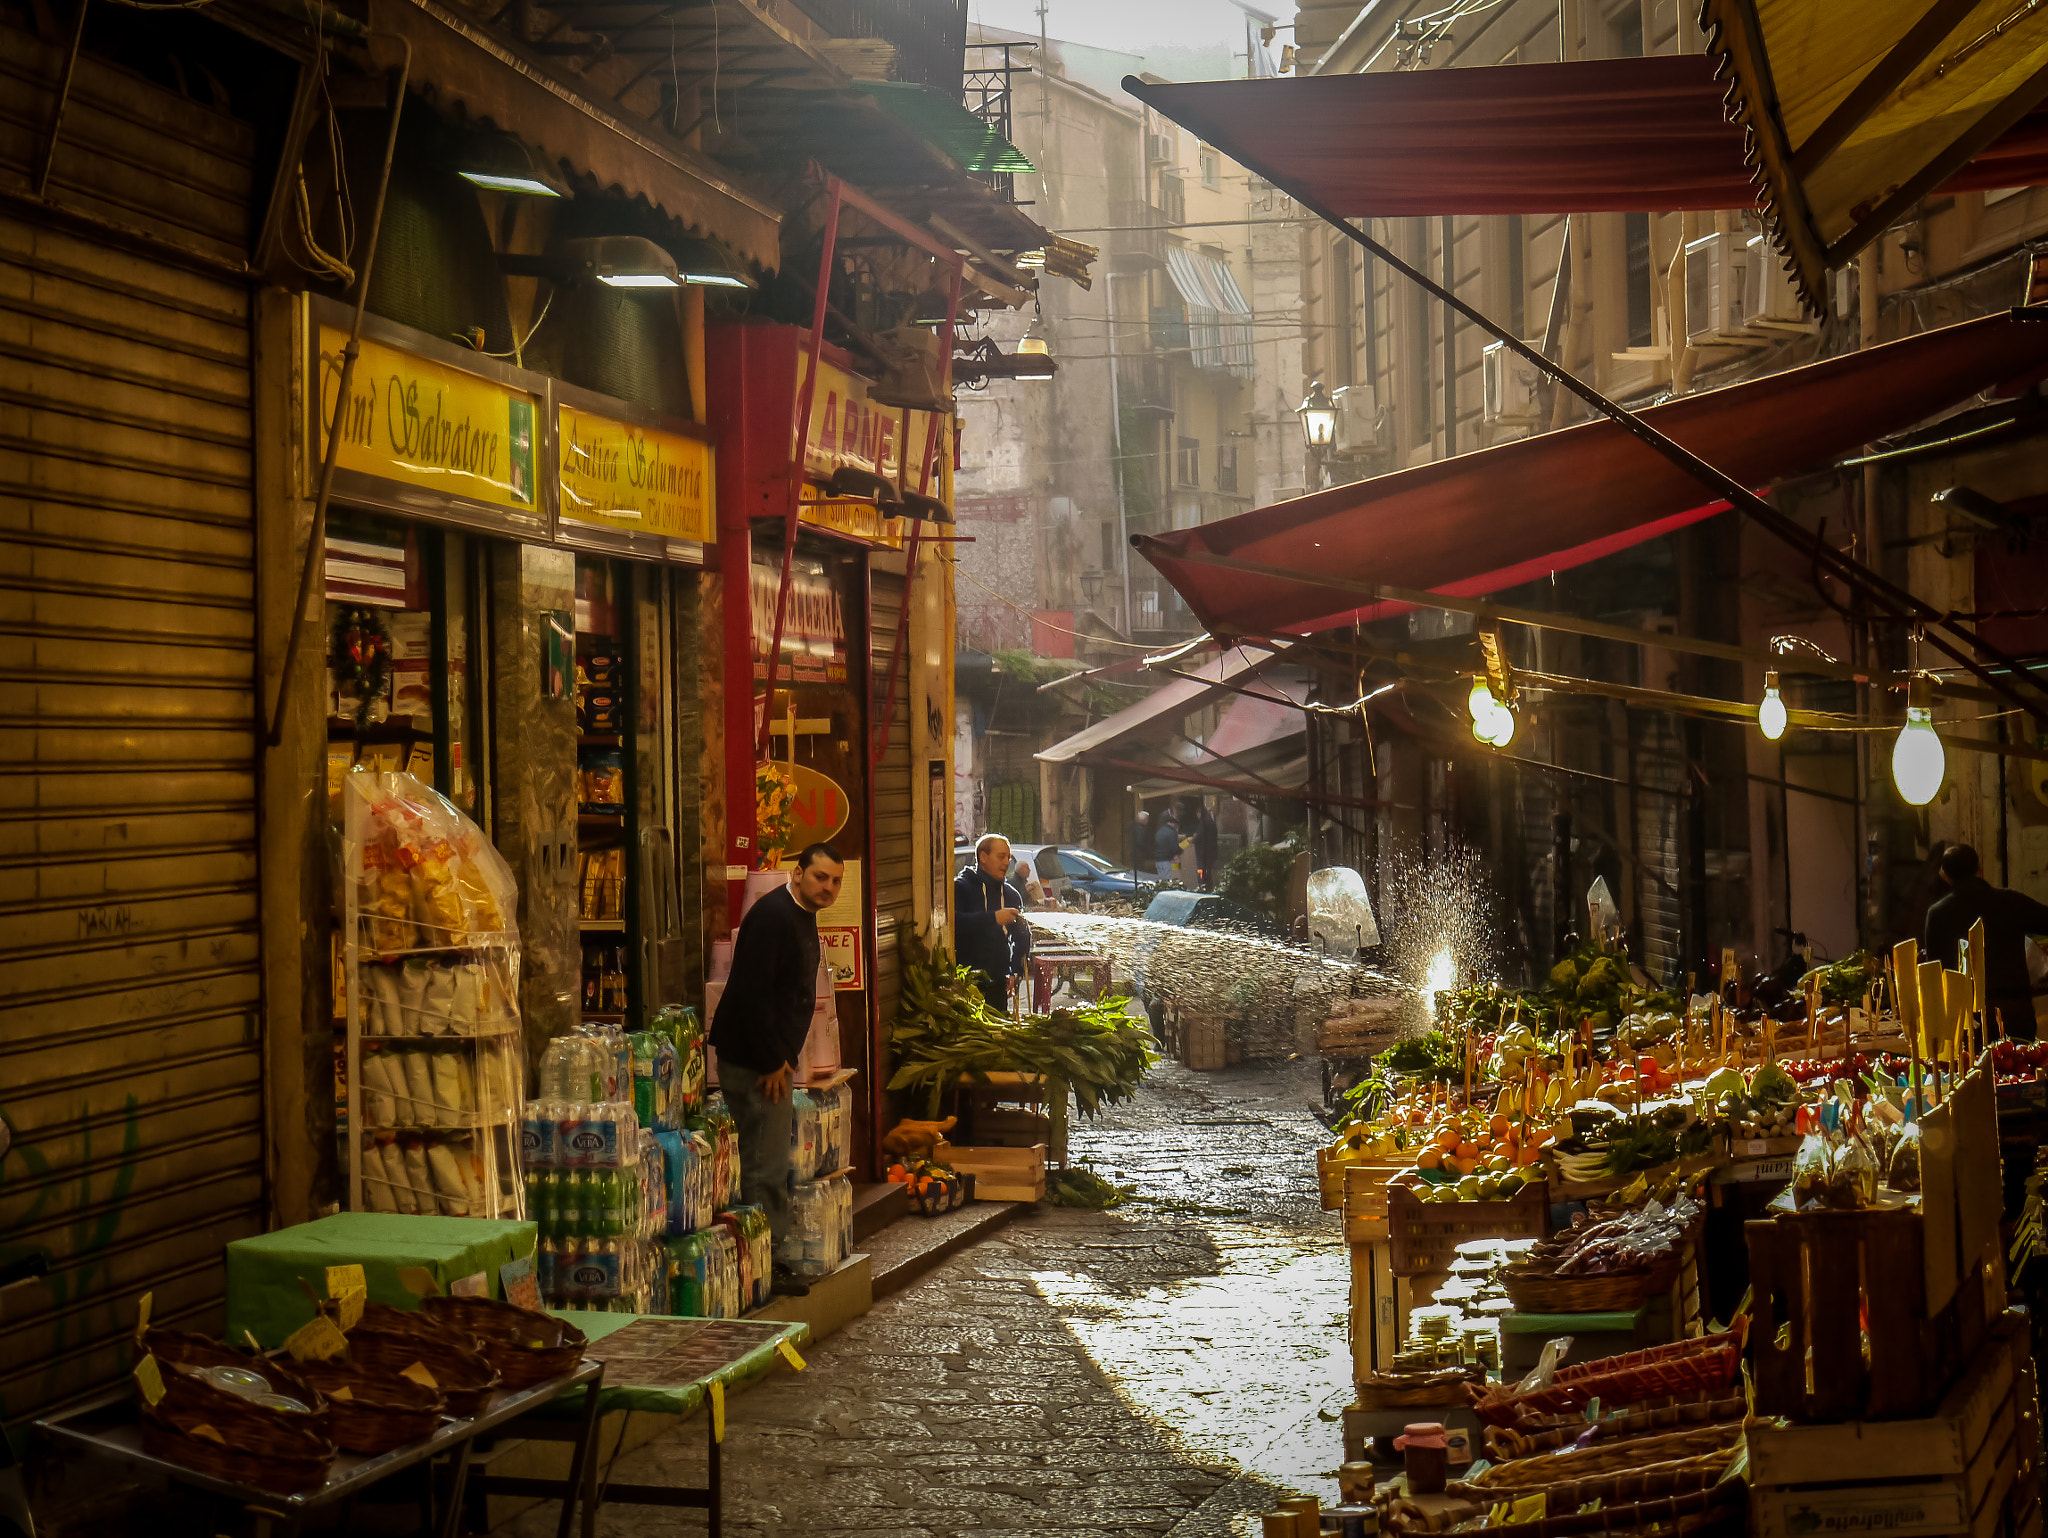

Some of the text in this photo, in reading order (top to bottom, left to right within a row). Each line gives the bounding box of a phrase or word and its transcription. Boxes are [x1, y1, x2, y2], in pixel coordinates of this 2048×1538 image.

[388, 374, 498, 477] Salvatore
[563, 416, 701, 499] Antica Salumeria
[576, 1137, 600, 1148] VERA
[577, 1271, 602, 1282] VERA
[1825, 1509, 1925, 1531] emiliafrutta
